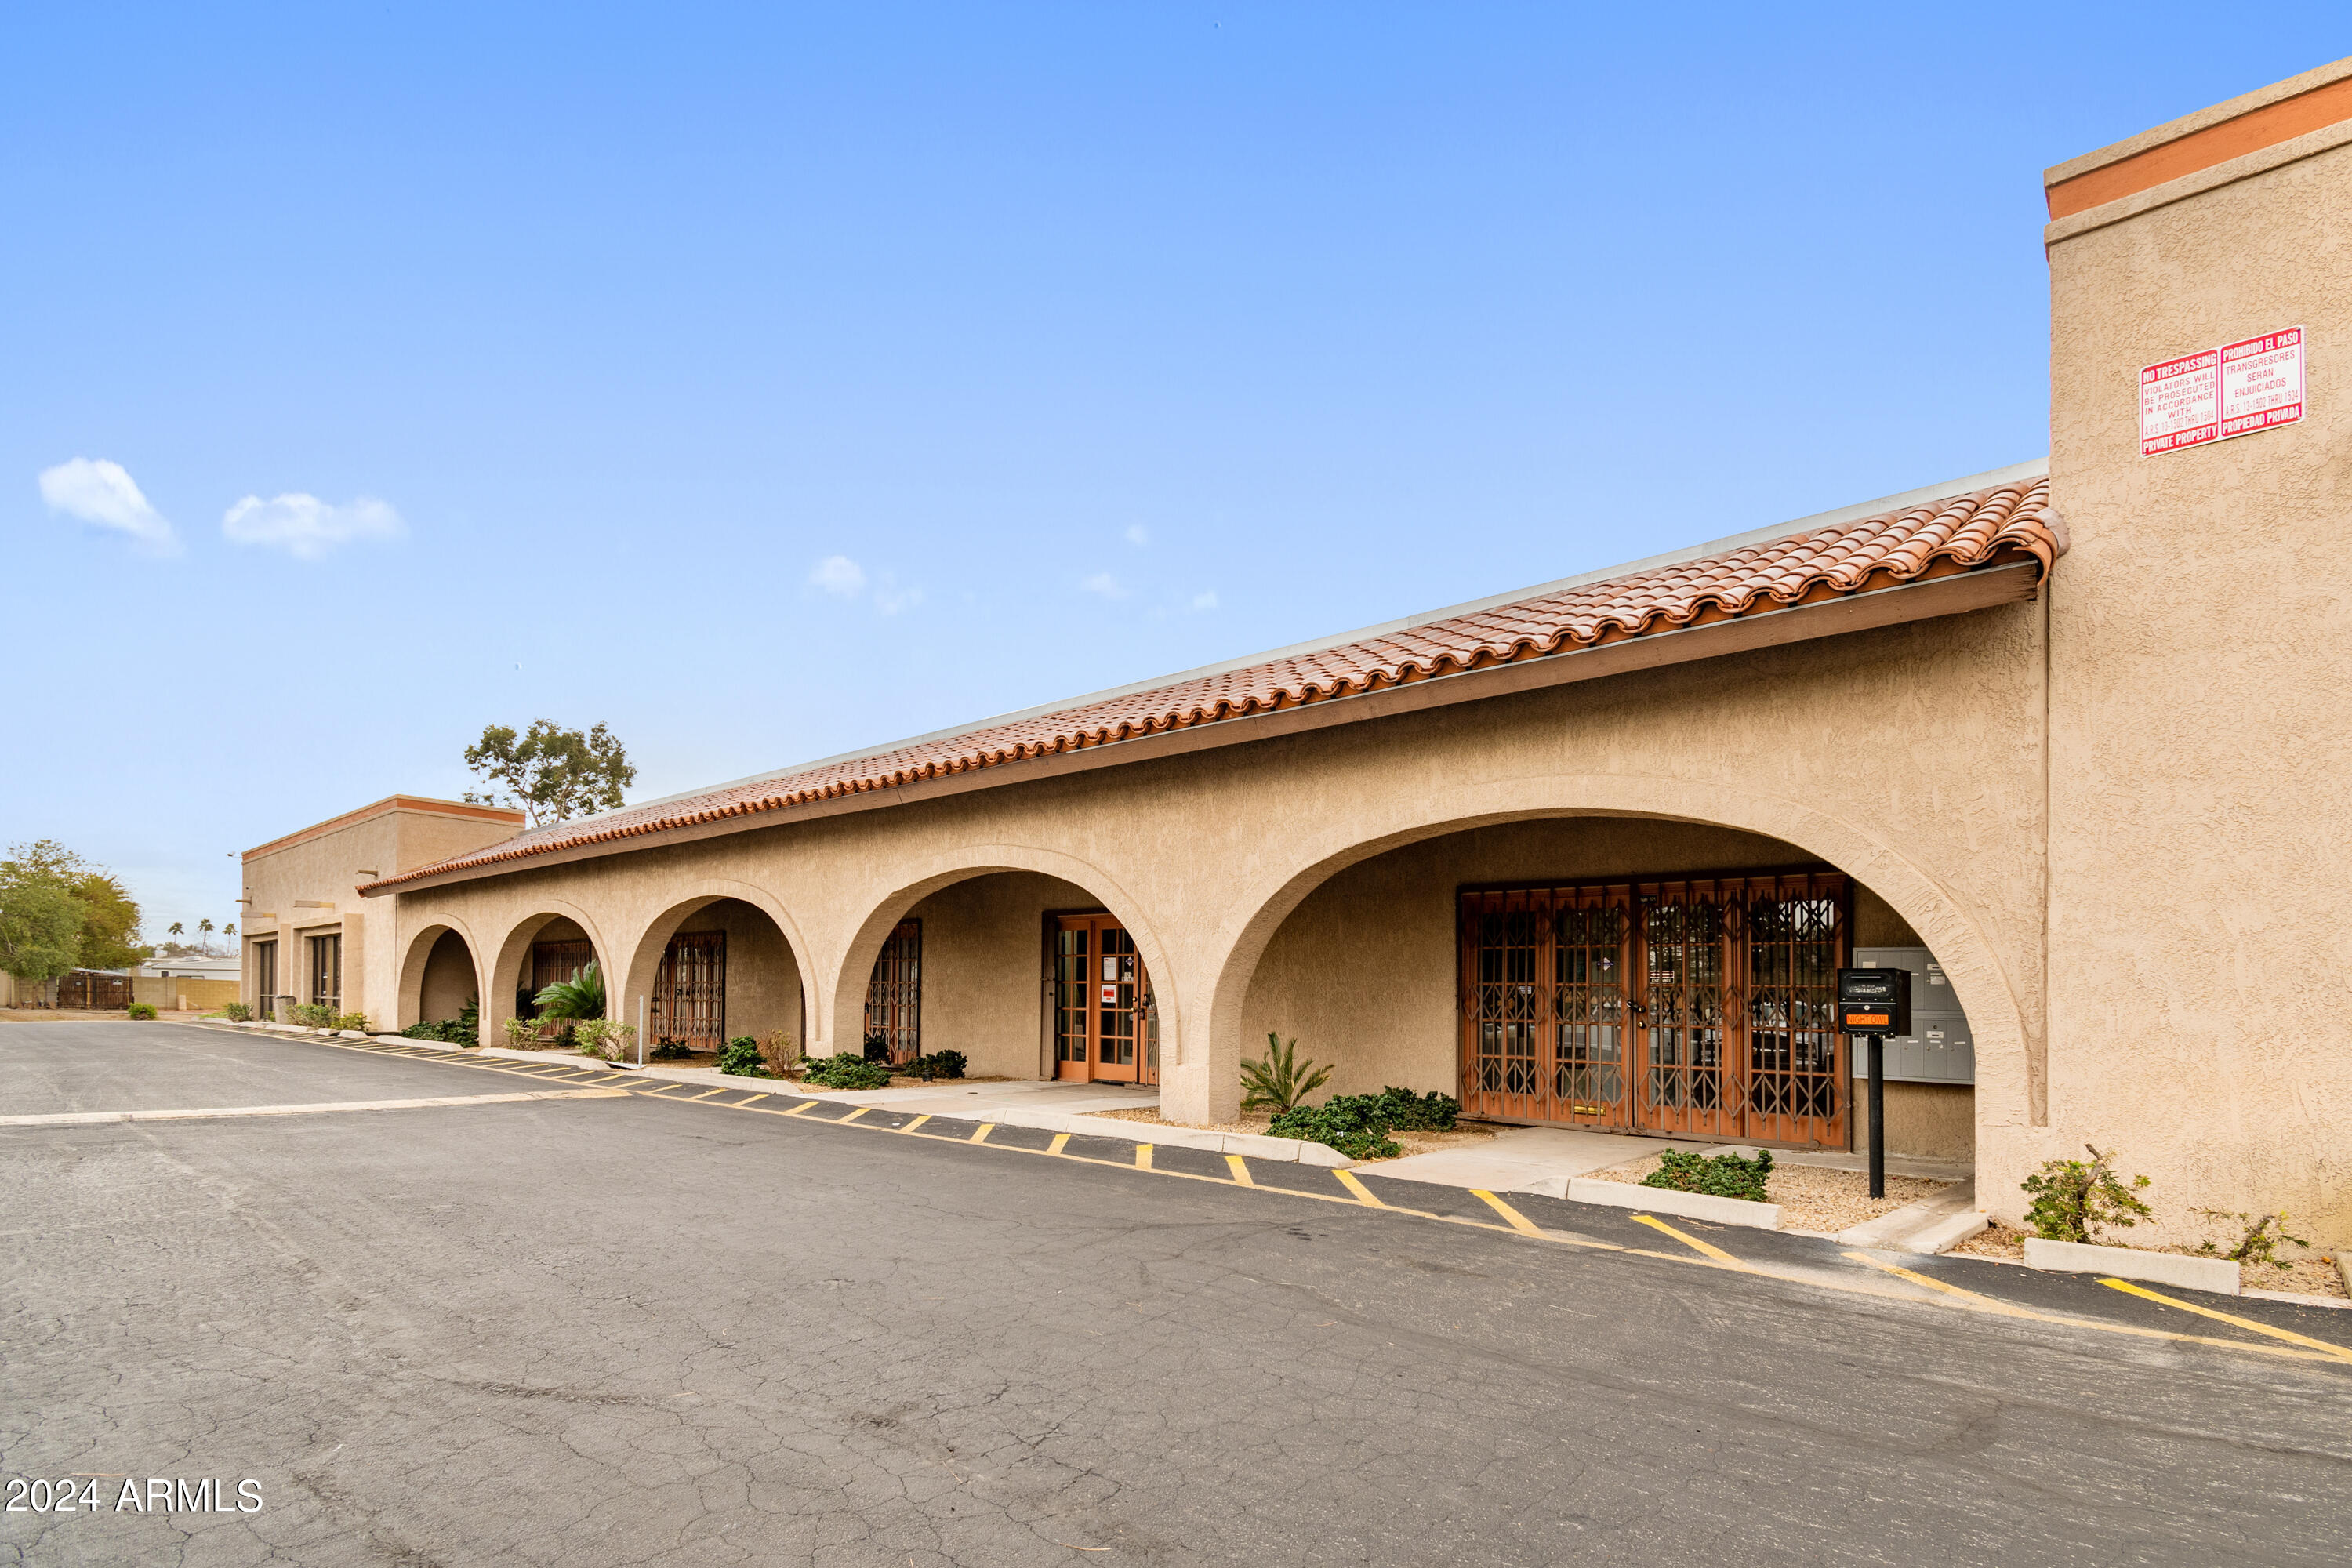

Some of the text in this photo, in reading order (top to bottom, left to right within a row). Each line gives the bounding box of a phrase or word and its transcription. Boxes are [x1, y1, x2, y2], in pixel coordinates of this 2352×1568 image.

[2223, 332, 2298, 361] PROHIBIDO EL PASO
[2143, 353, 2216, 383] NO TRESPASSING
[2226, 350, 2295, 375] TRANSGRESORES
[2144, 371, 2215, 395] VIOLATORS WILL
[2247, 368, 2274, 382] SERAN
[2144, 381, 2215, 405] BE PROSECUTED
[2234, 377, 2287, 398] ENJUICIADOS
[2268, 393, 2282, 407] THRU
[2285, 389, 2298, 402] 1504
[2145, 390, 2214, 415] IN ACCORDANCE
[2168, 406, 2191, 419] WITH
[2185, 414, 2199, 426] THRU
[2223, 406, 2300, 434] PROPIEDAD PRIVADA
[2143, 424, 2218, 454] PRIVATE PROPERTY
[1847, 1015, 1888, 1024] NIGHT OWL
